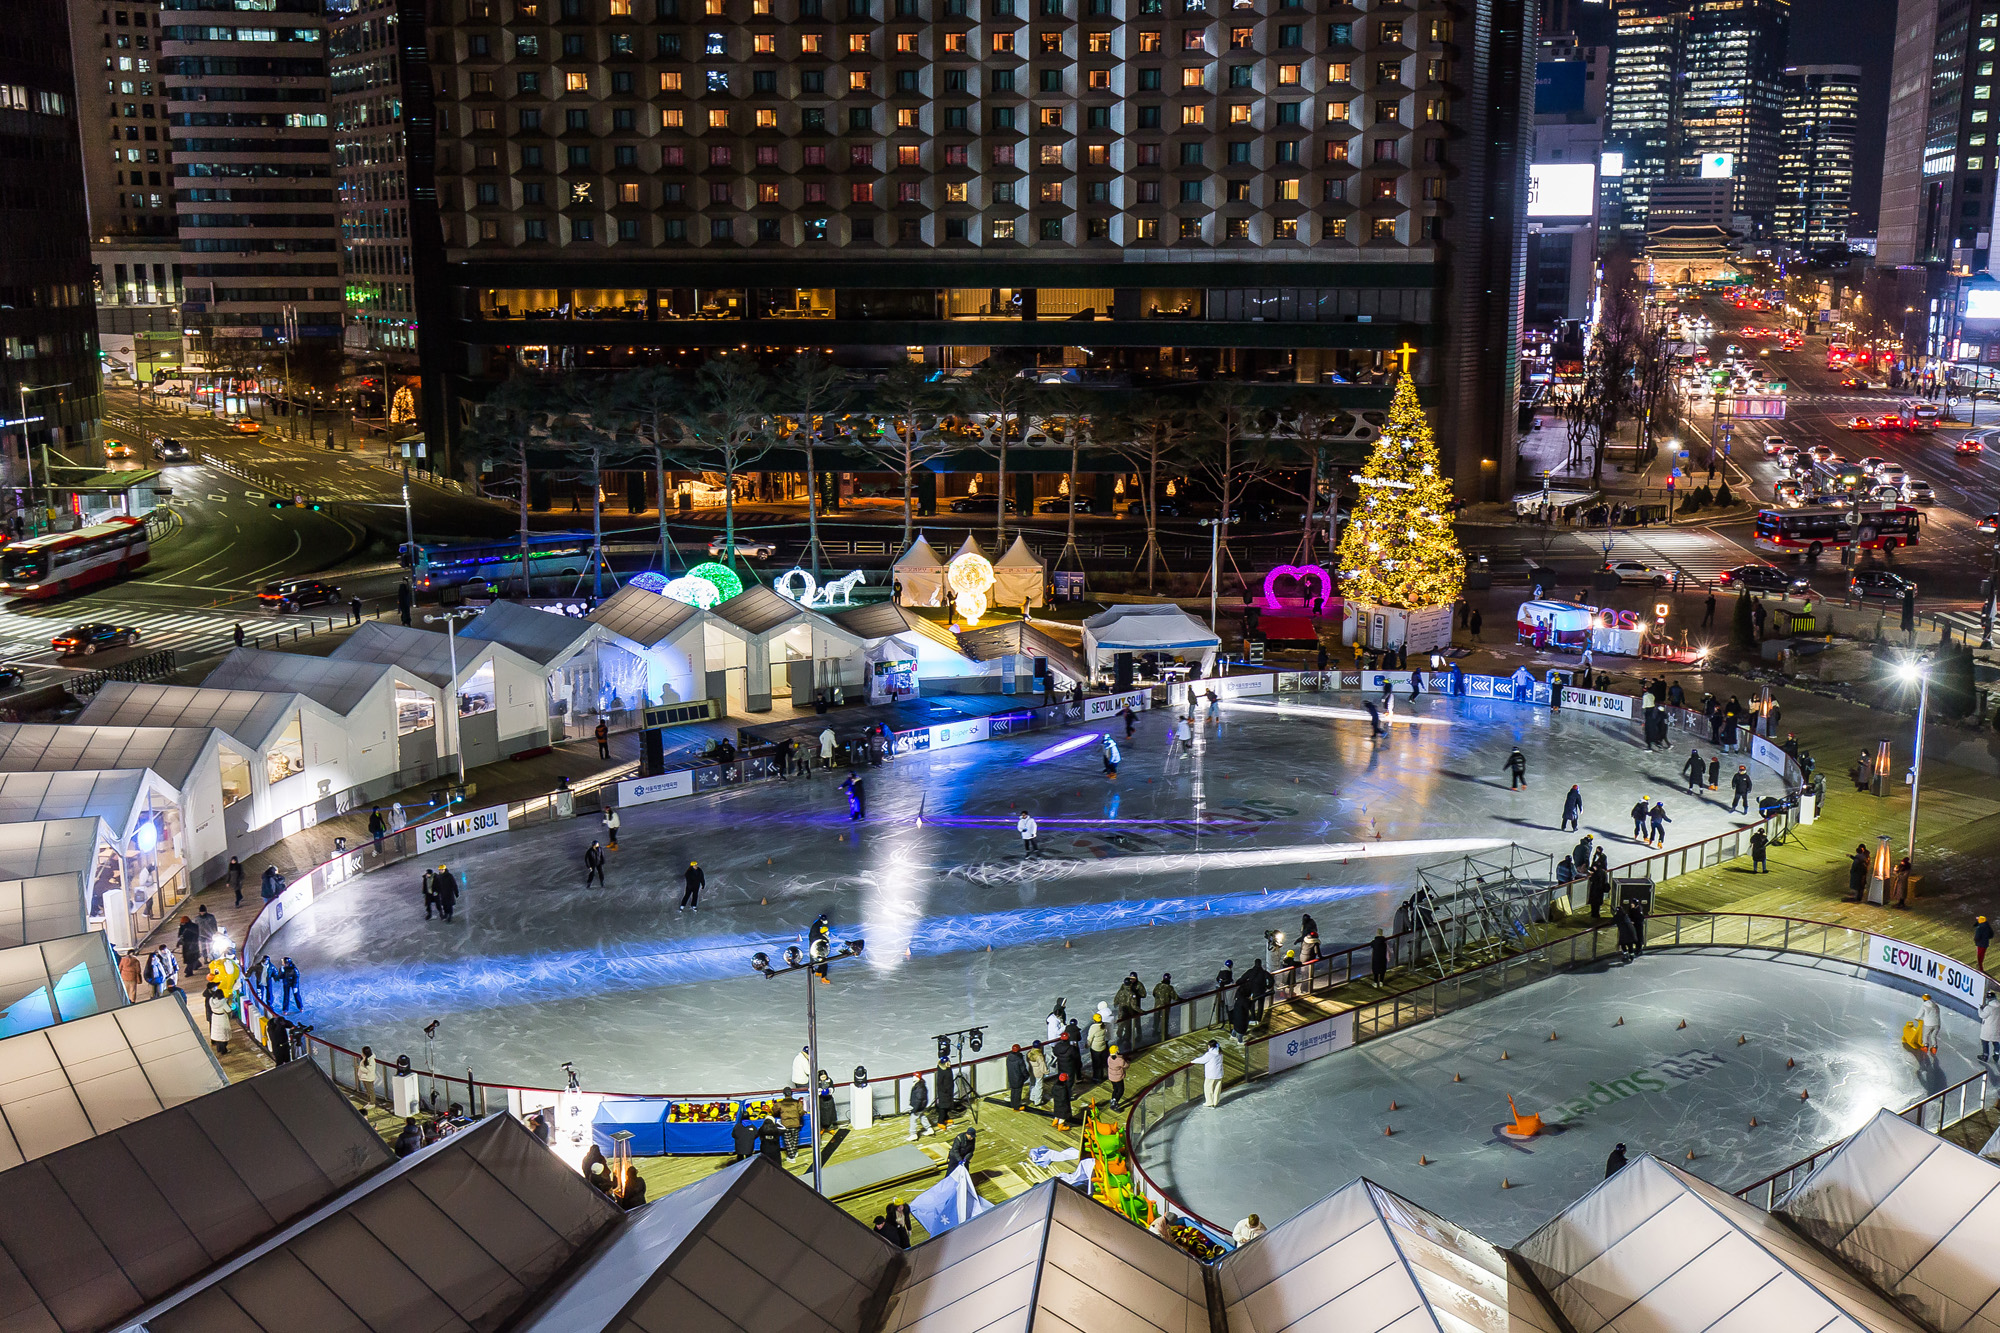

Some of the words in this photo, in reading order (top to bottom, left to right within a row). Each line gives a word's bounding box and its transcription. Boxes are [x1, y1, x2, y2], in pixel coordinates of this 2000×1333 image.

[1351, 475, 1377, 487] Merry
[1377, 477, 1416, 489] Christmas
[1603, 697, 1624, 712] SOUL
[473, 812, 499, 831] SOUL
[1947, 968, 1974, 997] SOUL
